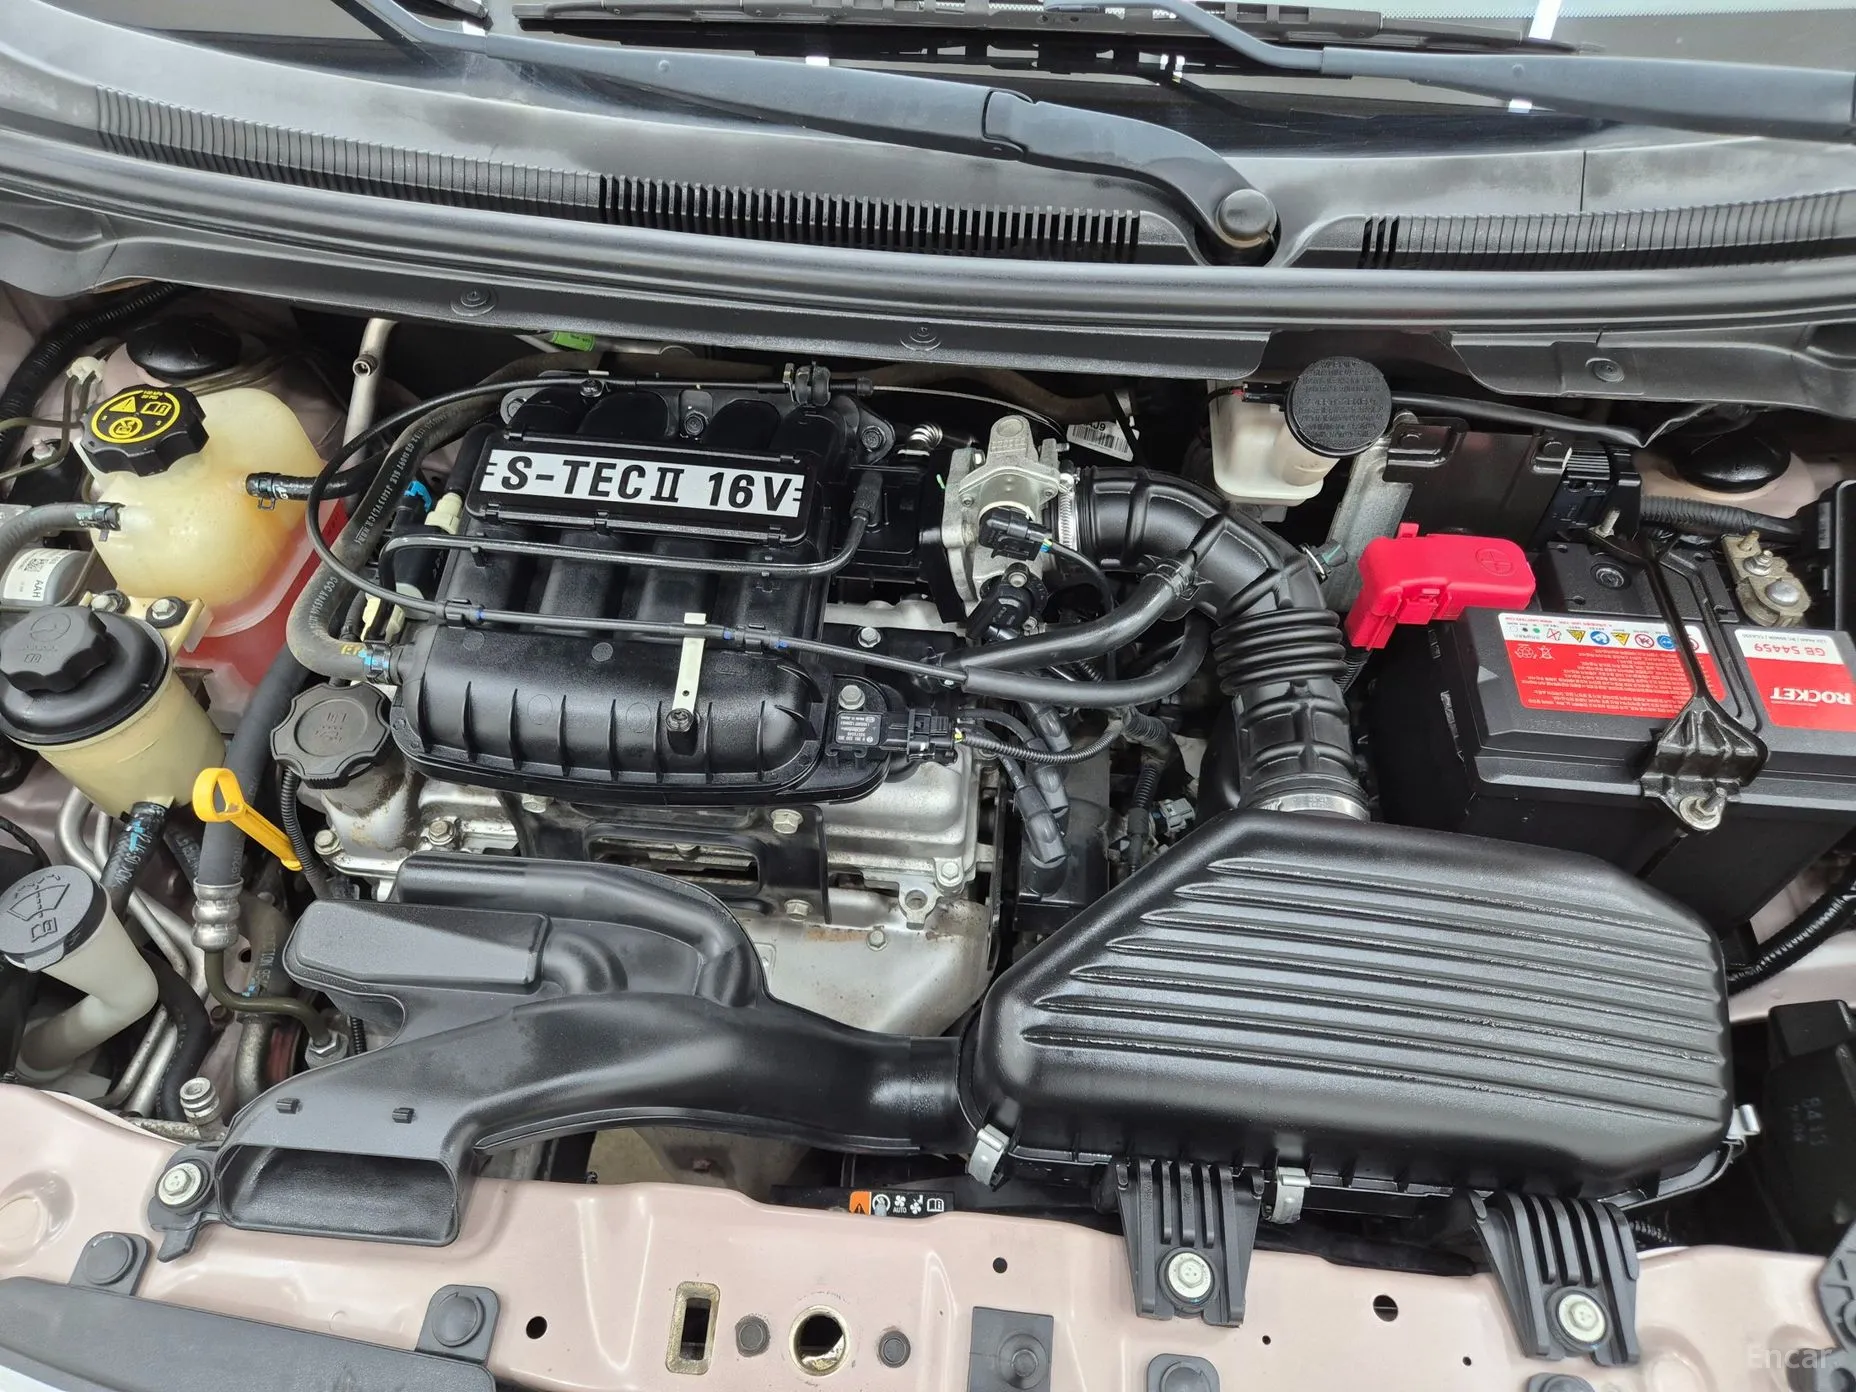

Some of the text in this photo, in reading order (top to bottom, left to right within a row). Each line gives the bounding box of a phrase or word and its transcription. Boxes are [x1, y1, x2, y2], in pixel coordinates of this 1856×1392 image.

[708, 471, 793, 512] 16V
[1753, 642, 1826, 657] GB 54459
[1769, 686, 1855, 706] ROCKET
